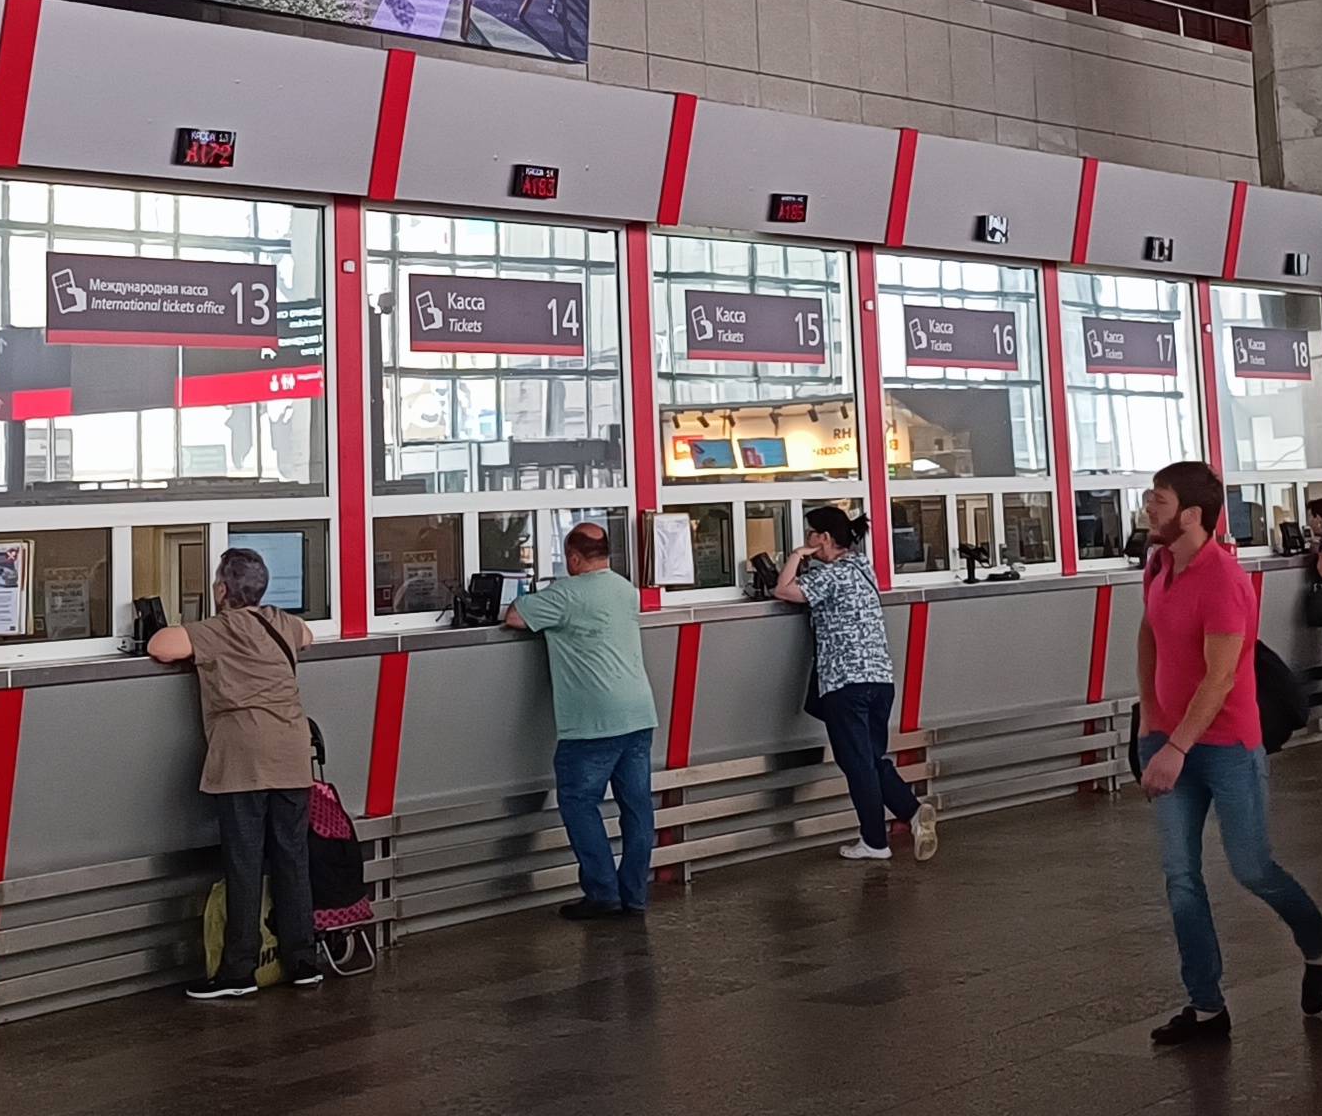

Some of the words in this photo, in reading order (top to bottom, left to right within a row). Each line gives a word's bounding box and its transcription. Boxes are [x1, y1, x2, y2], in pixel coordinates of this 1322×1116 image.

[89, 278, 178, 296] Международная
[180, 286, 208, 297] касса
[230, 282, 271, 325] 13
[91, 297, 161, 313] International
[162, 300, 195, 314] tickets
[197, 302, 226, 316] office
[447, 292, 486, 312] Касса
[547, 298, 579, 337] 14
[449, 318, 482, 334] Tickets
[715, 306, 747, 324] Касса
[794, 312, 821, 347] 15
[717, 329, 745, 343] Tickets
[928, 319, 954, 335] Касса
[992, 323, 1015, 355] 16
[930, 339, 953, 352] Tickets
[1156, 334, 1173, 363] 17
[1292, 341, 1309, 369] 18
